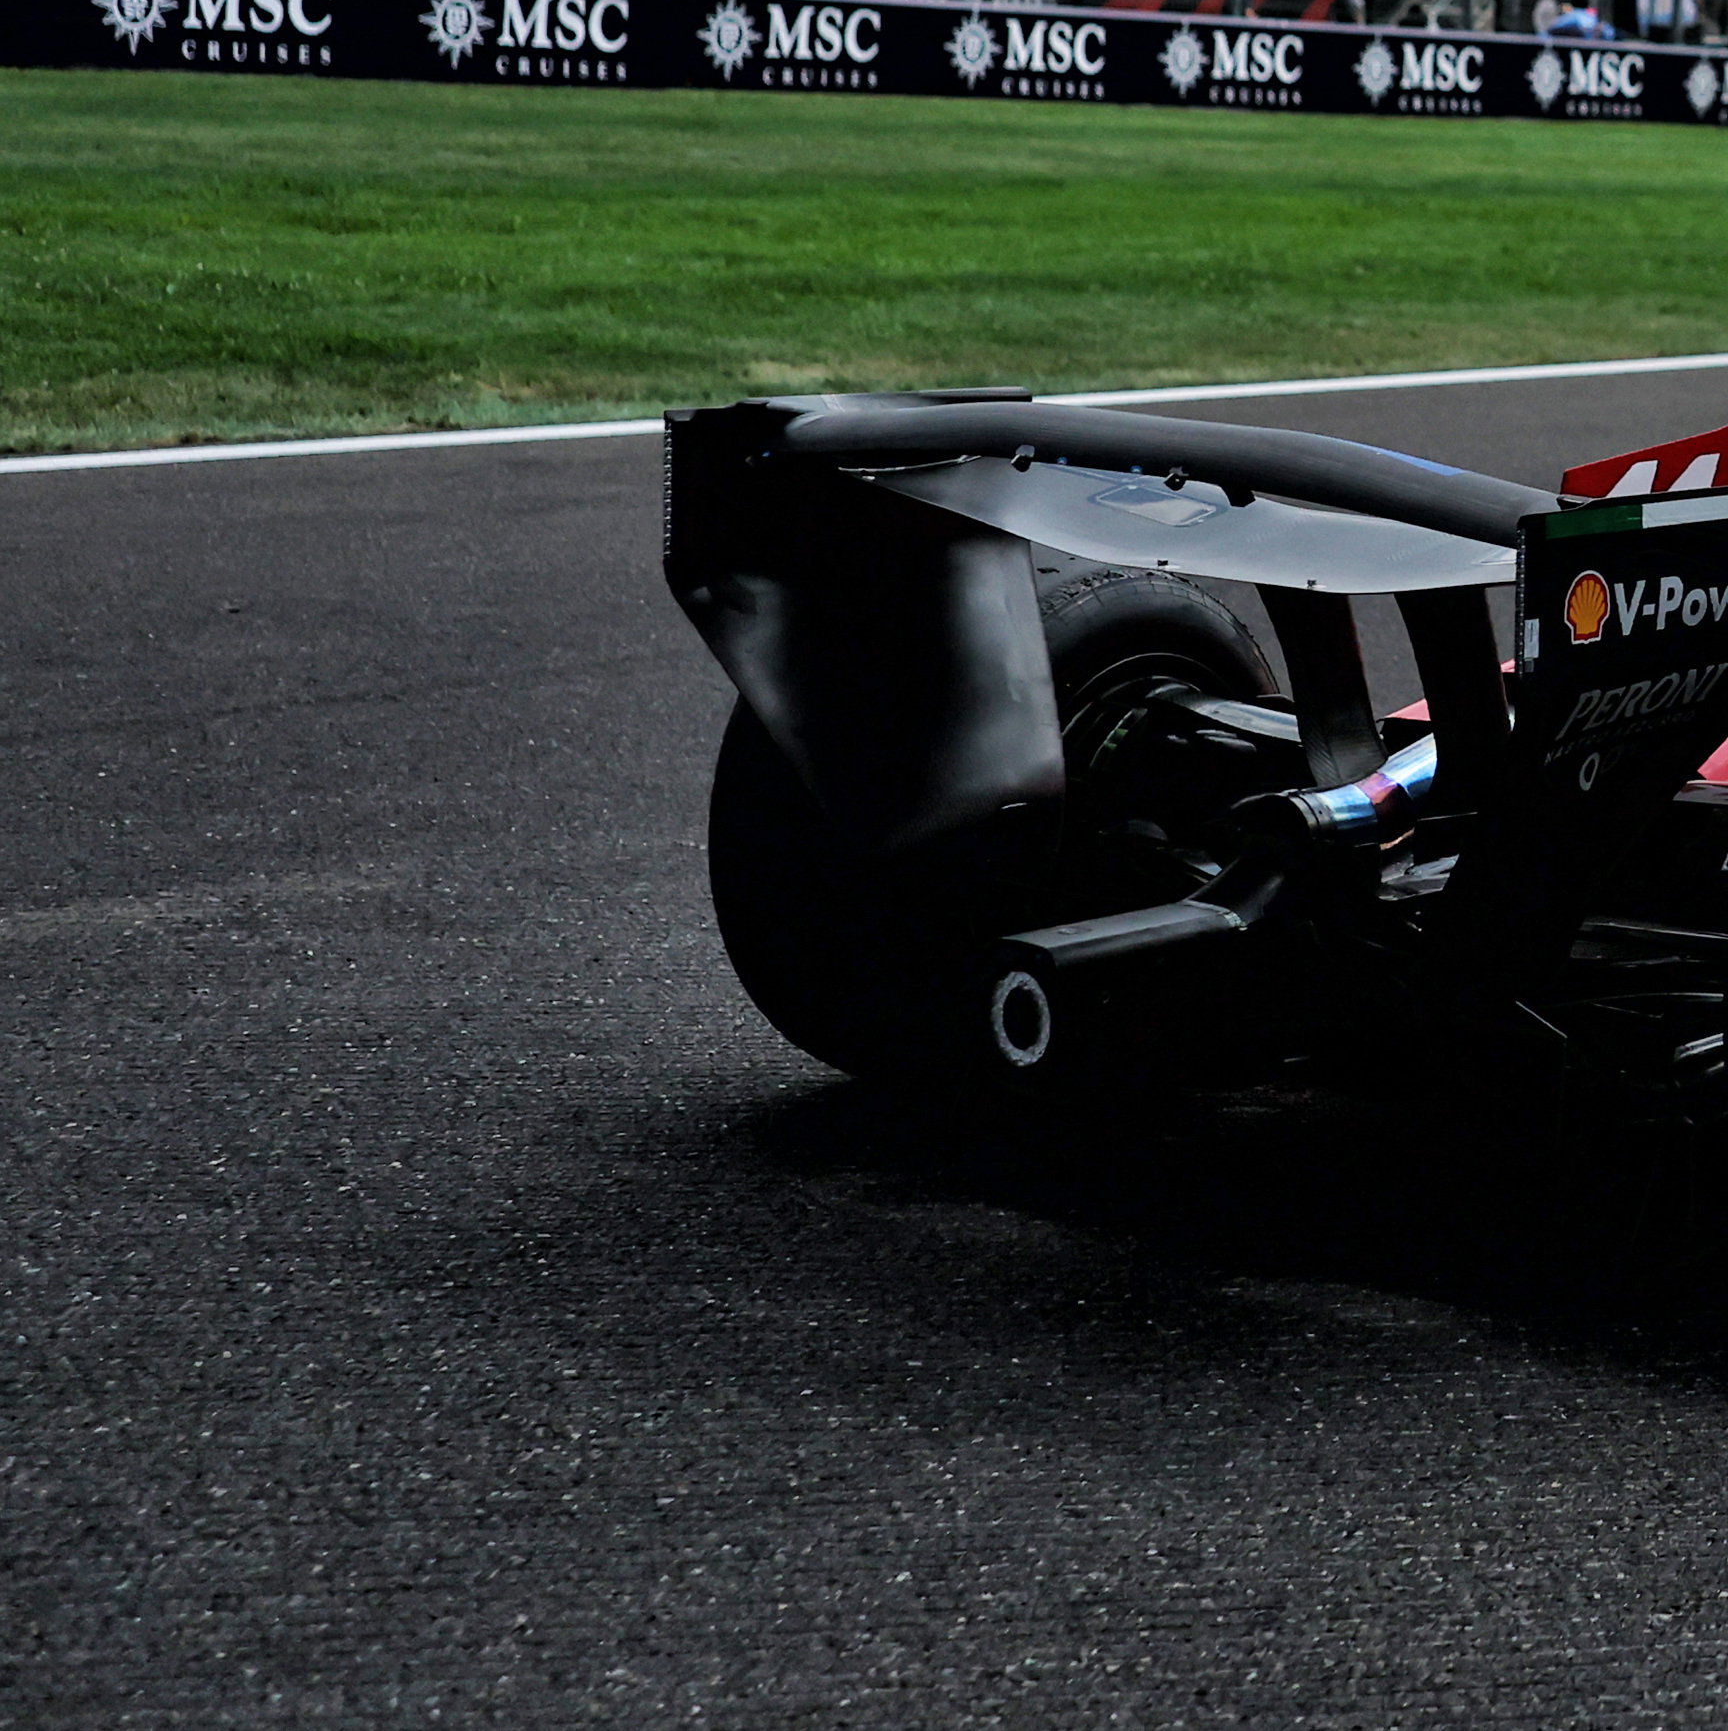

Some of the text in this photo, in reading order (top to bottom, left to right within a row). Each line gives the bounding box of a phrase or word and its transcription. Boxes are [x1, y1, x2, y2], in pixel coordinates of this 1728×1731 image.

[181, 38, 331, 66] CRUISES
[764, 3, 882, 63] MSC
[1003, 18, 1106, 75] MSC
[1211, 30, 1304, 84] MSC
[495, 54, 627, 82] CRUISES
[1400, 42, 1484, 93] MSC
[1568, 50, 1645, 98] MSC
[1554, 662, 1728, 741] PERONI
